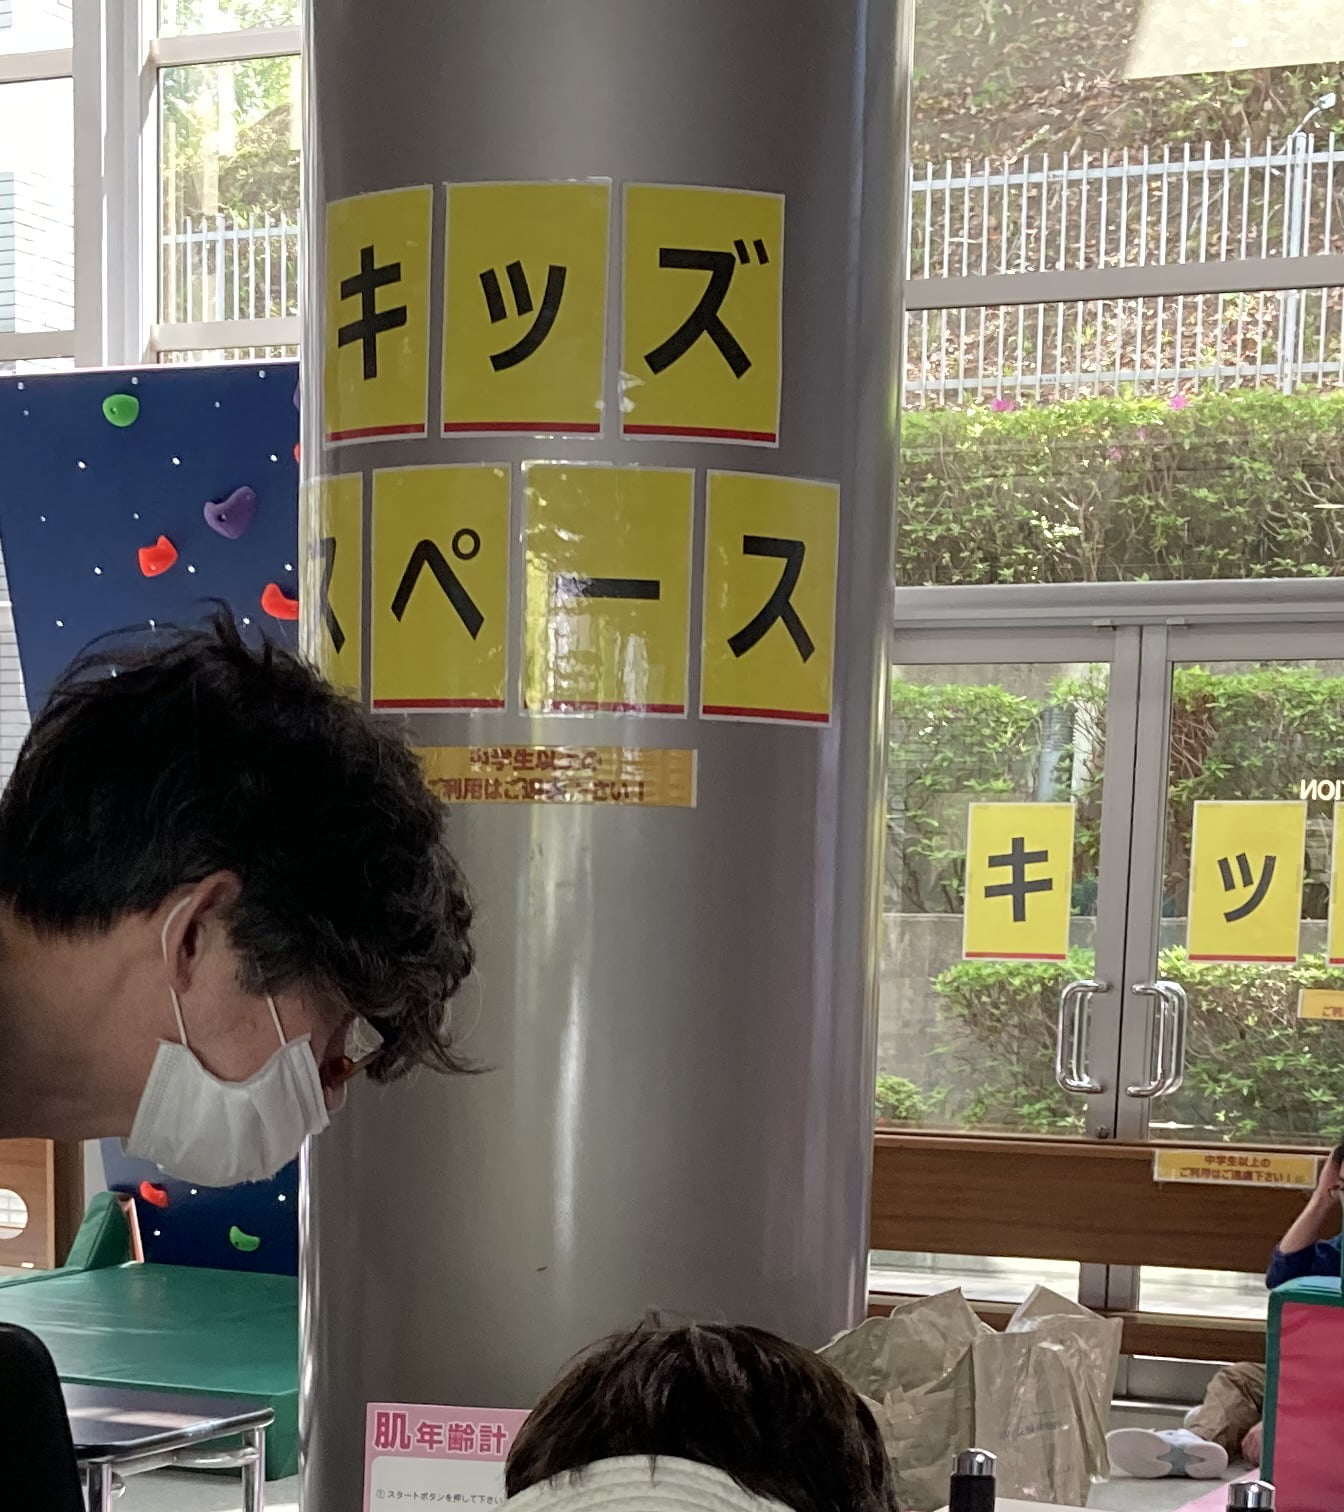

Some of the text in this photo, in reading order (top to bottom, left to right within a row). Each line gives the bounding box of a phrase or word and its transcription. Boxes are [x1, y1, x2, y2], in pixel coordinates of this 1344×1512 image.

[337, 238, 770, 381] キッズ
[1205, 1155, 1271, 1168] 中学生以上の
[373, 1411, 508, 1454] 肌年齢計
